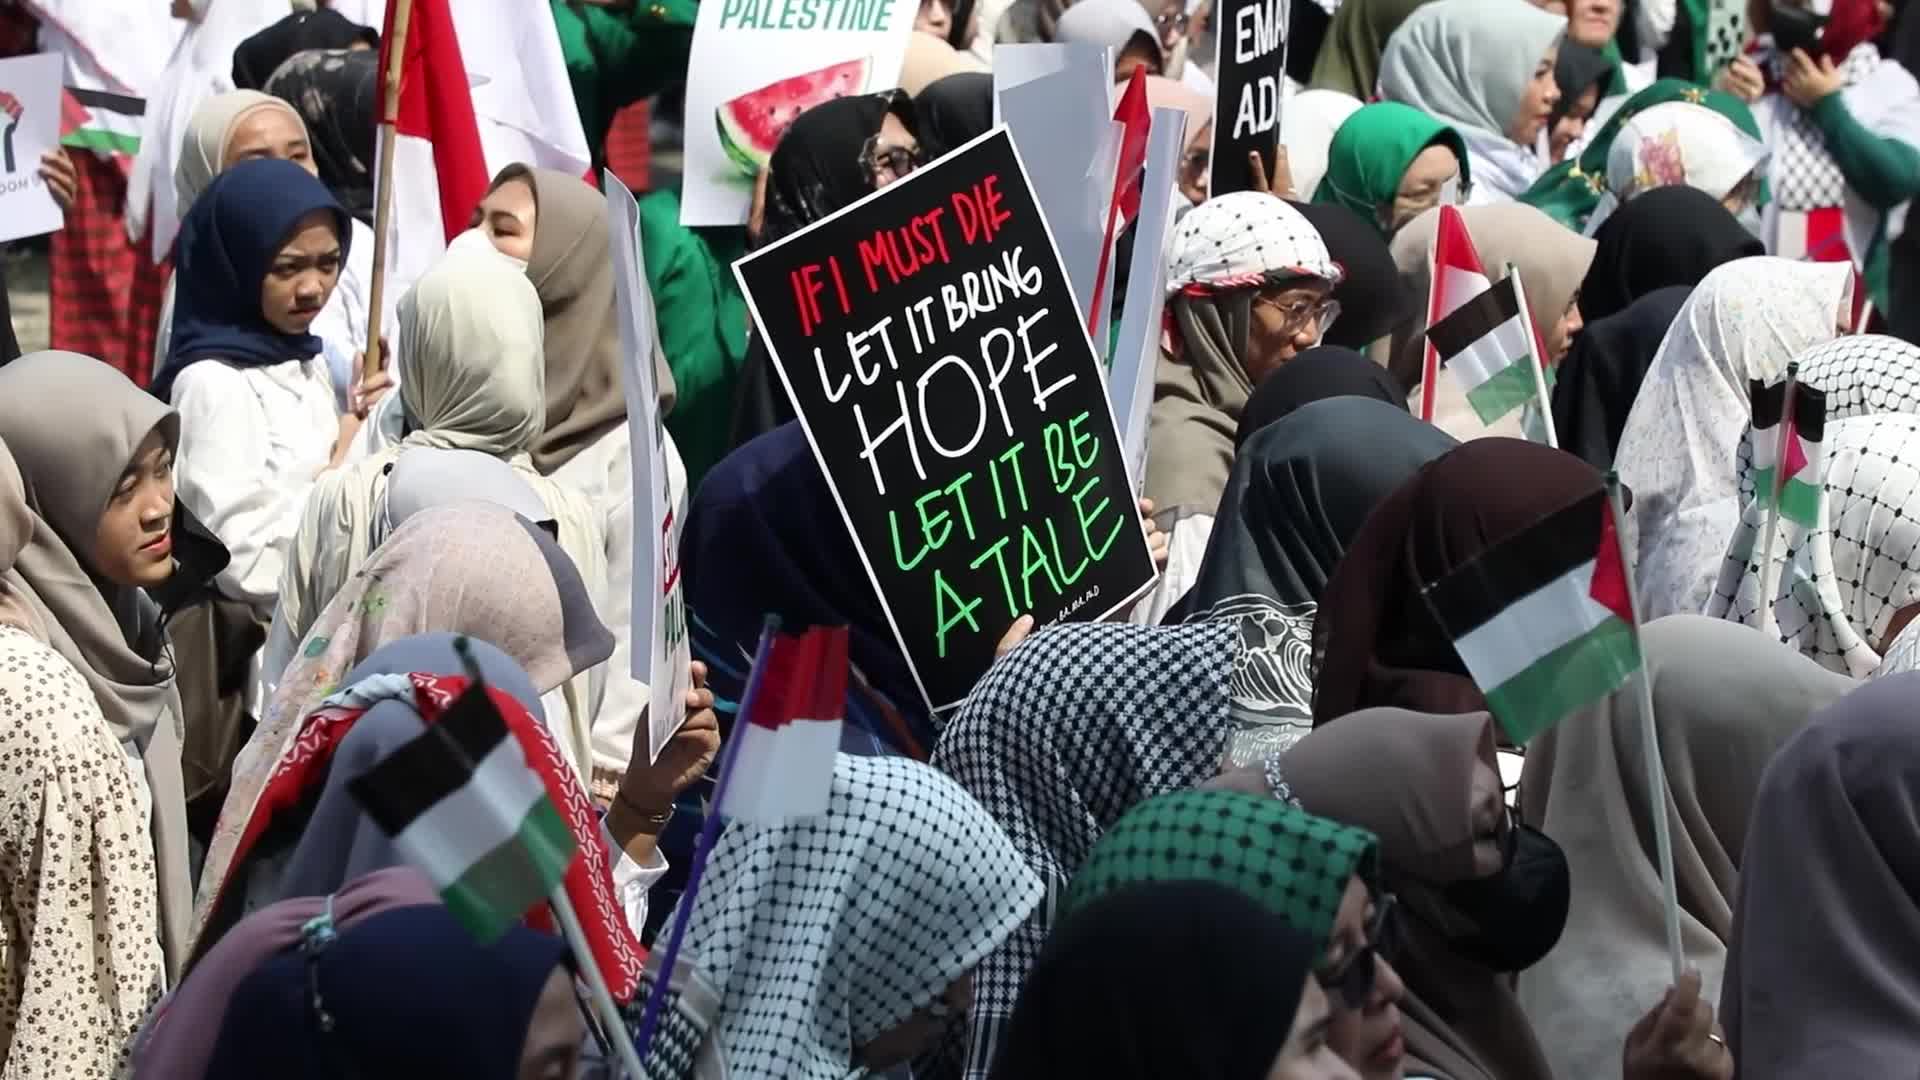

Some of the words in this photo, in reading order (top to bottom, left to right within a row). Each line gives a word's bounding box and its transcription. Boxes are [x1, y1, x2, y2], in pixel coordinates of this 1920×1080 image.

[719, 0, 896, 31] PALESTINE
[791, 265, 824, 336] IF
[827, 255, 850, 314] I
[858, 207, 950, 293] MUST
[951, 174, 1011, 244] DIE
[814, 316, 898, 402] LET
[905, 296, 936, 354] IT
[941, 246, 1043, 332] BRING
[853, 308, 1076, 494] HOPE
[889, 472, 975, 570] LET
[989, 441, 1024, 519] IT
[1044, 411, 1099, 493] BE
[934, 569, 983, 657] A
[970, 476, 1124, 618] TALE
